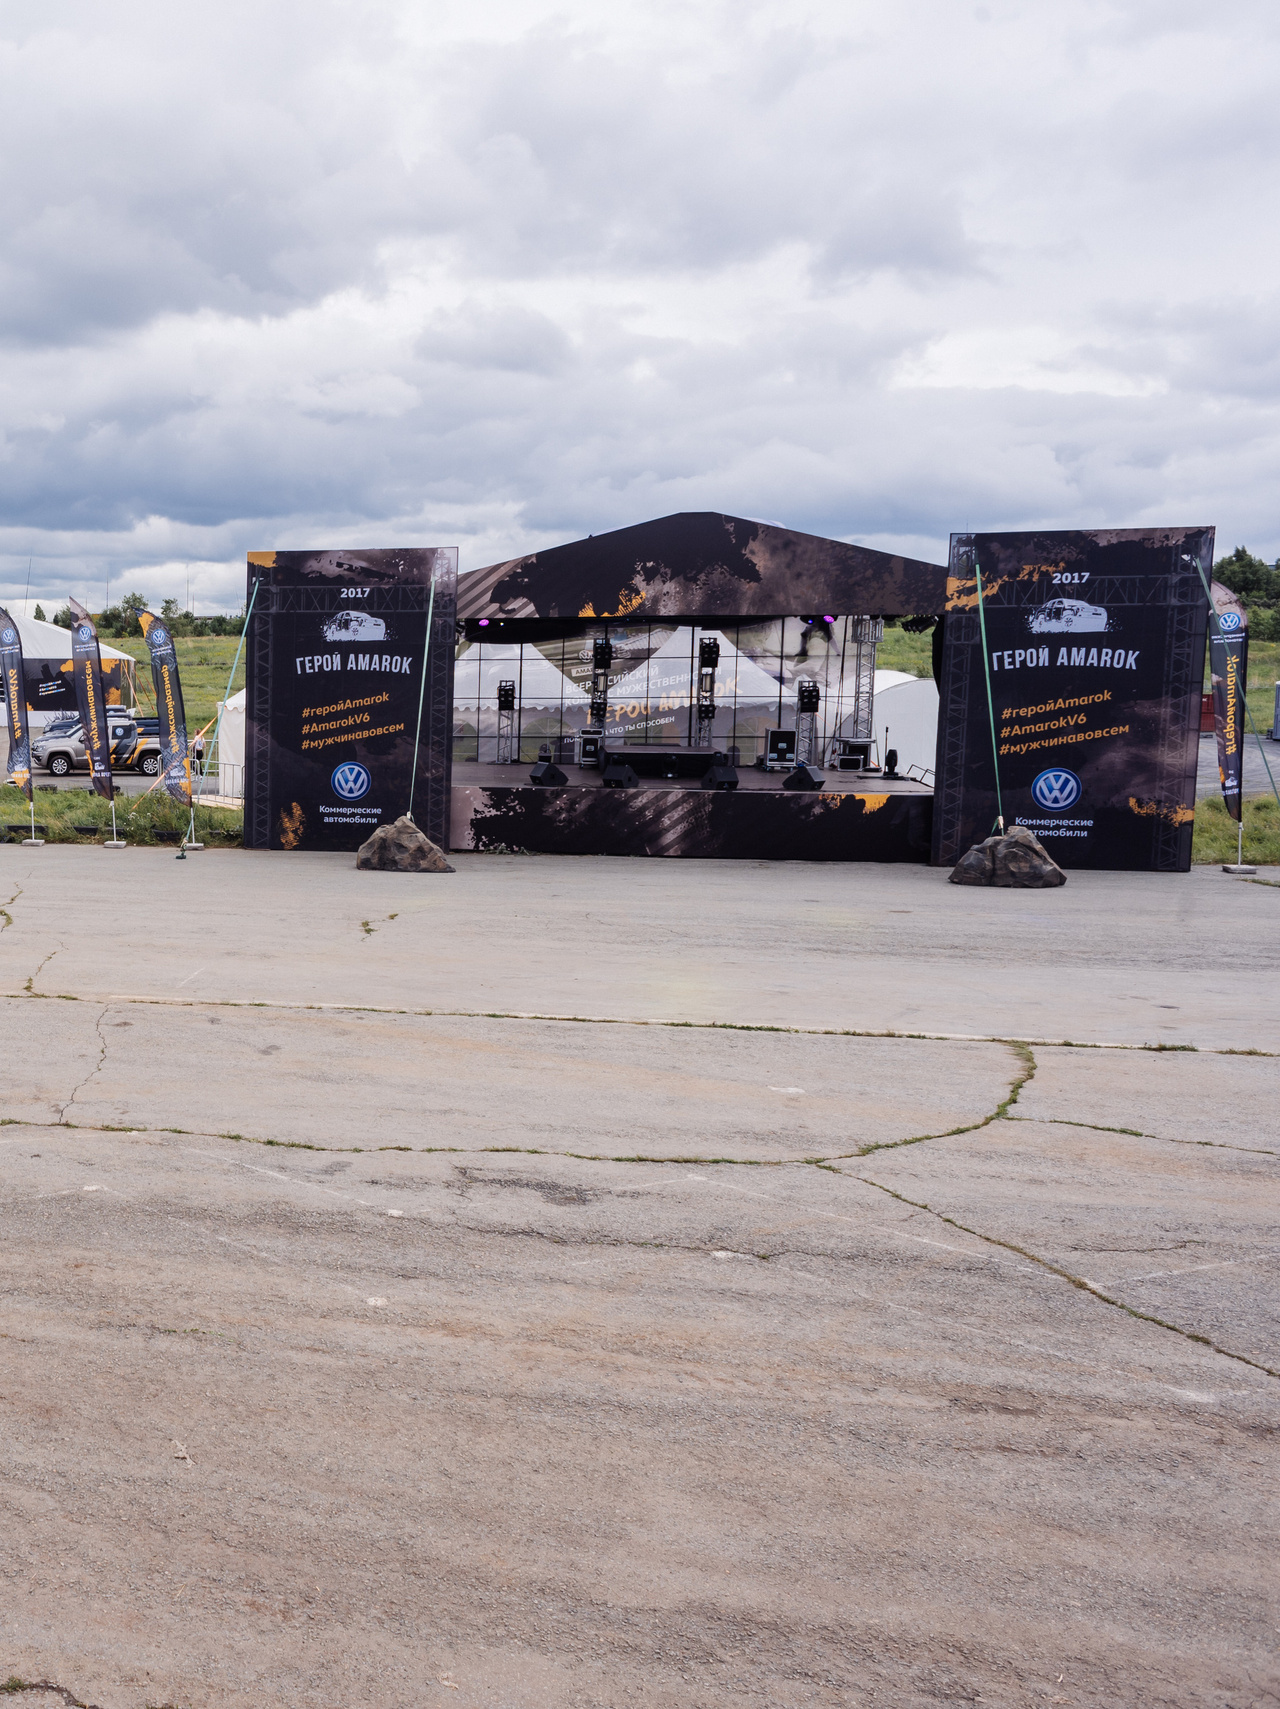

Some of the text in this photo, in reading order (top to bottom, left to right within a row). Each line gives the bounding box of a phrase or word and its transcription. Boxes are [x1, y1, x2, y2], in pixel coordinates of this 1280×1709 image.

[1052, 572, 1090, 584] 2017
[340, 588, 370, 598] 2017
[296, 652, 412, 675] ГЕРОЙ AMAROK
[992, 645, 1140, 671] ГЕРОЙ AMAROK
[302, 692, 389, 718] #геройAmarok
[1001, 690, 1112, 720] #геройAmarok
[302, 713, 370, 735] #AmarokV6
[1000, 713, 1087, 738] #AmarokV6
[301, 721, 404, 750] #мужчинавовсем
[999, 724, 1130, 756] #мужчинавовсем
[320, 805, 382, 815] Коммерческие
[323, 814, 378, 824] автомобили
[1015, 817, 1094, 827] Коммерческие
[1030, 828, 1088, 838] томобили
